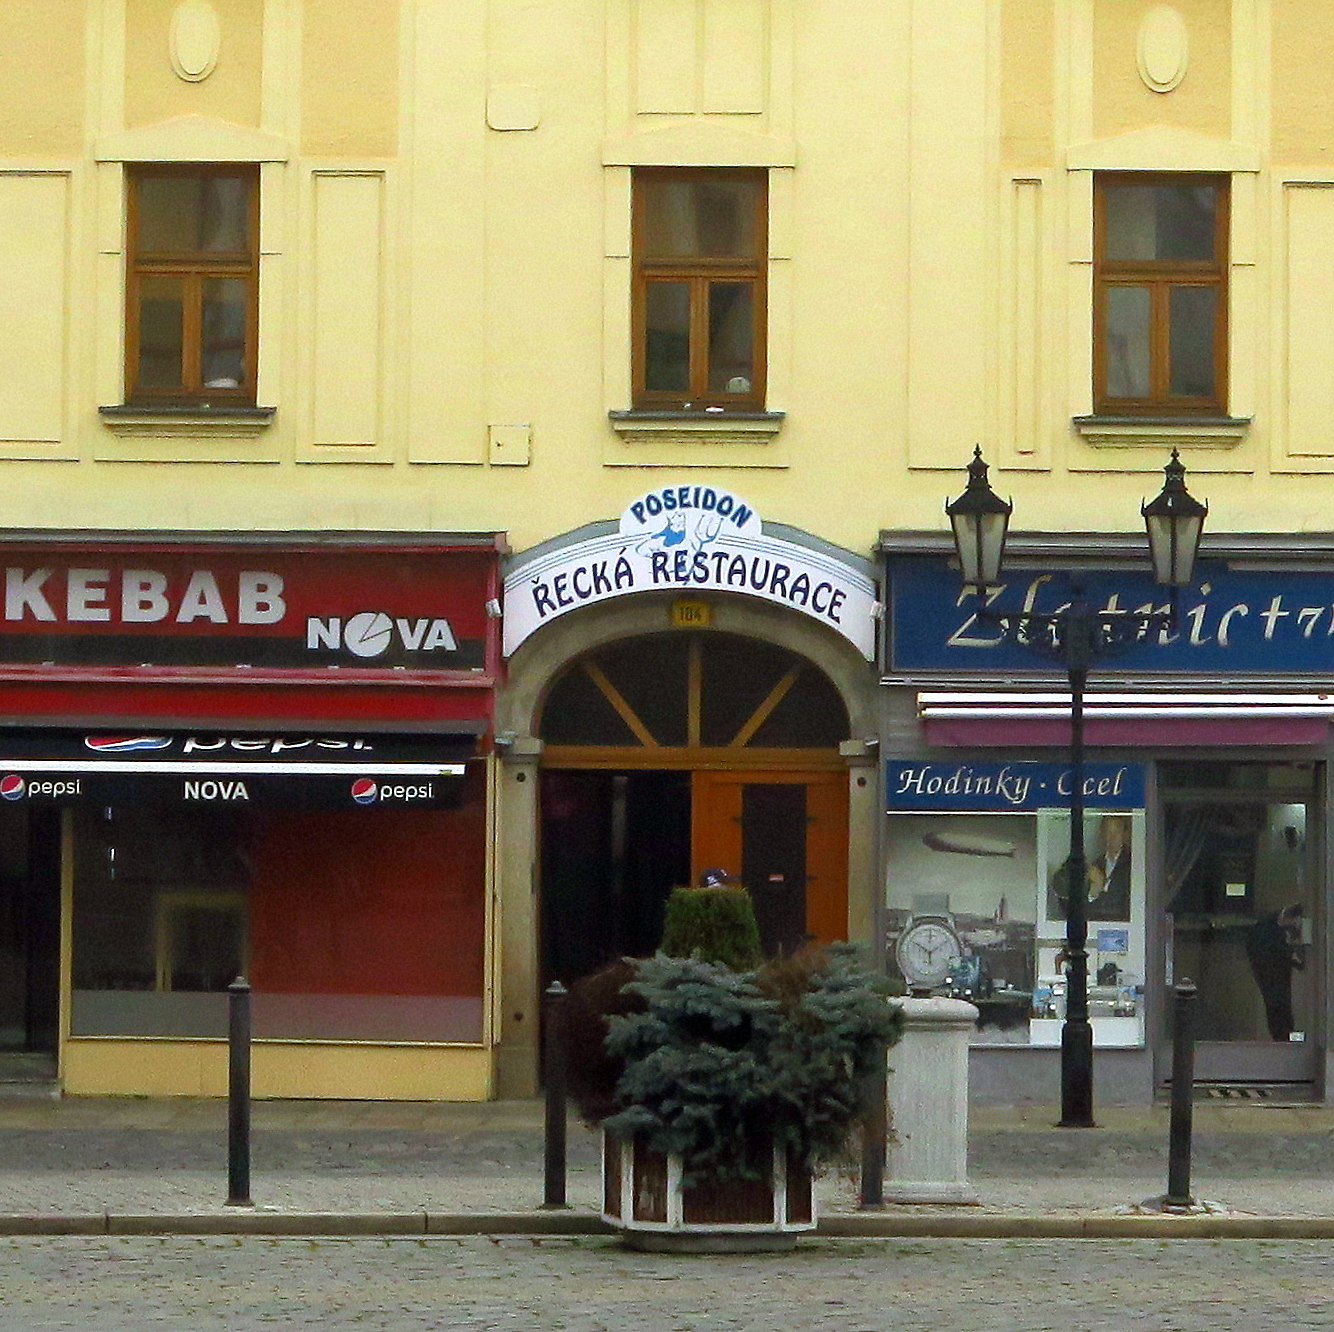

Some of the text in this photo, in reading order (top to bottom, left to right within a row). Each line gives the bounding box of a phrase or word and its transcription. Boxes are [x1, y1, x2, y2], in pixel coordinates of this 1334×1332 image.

[630, 486, 753, 529] POSEIDON
[4, 567, 288, 625] KEBAB
[531, 548, 847, 624] ŘECKÁ RESTAURACE
[306, 611, 458, 657] NOVA
[28, 779, 81, 798] pepsi
[184, 781, 249, 801] NOVA
[380, 783, 434, 801] pepsi
[896, 766, 1032, 804] Hodinky
